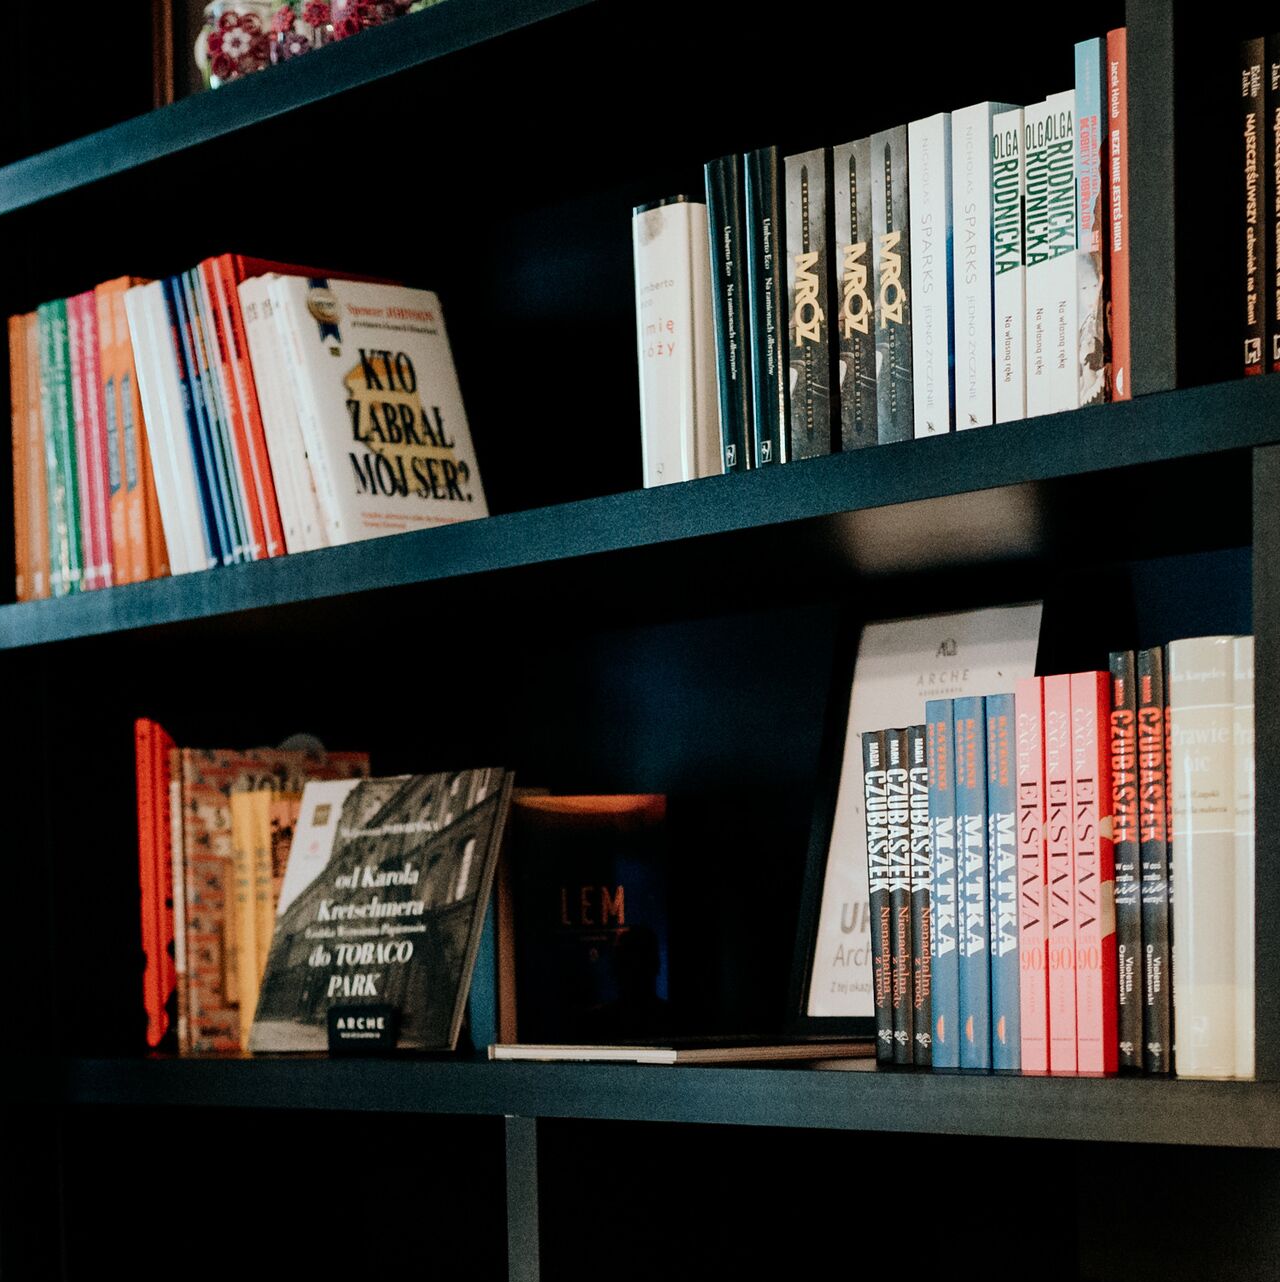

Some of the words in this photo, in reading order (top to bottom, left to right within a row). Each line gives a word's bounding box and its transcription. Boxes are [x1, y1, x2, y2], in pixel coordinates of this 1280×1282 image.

[1111, 61, 1119, 87] Jacek
[993, 128, 1018, 159] OLGA
[1025, 121, 1048, 151] OLGA
[1046, 111, 1073, 141] OLGA
[993, 158, 1020, 276] RUDNICKA
[1025, 149, 1048, 269] RUDNICKA
[1047, 140, 1075, 260] RUDNICKA
[880, 230, 906, 329] MRÓZ
[920, 214, 933, 295] SPARKS
[964, 203, 977, 285] SPARKS
[794, 250, 825, 348] MRÓZ
[844, 240, 873, 340] MRÓZ
[359, 348, 417, 394] KTO
[346, 399, 455, 449] ZABRAŁ
[349, 448, 410, 497] MÓJ
[411, 456, 473, 502] SER?
[917, 668, 970, 685] ARCHE
[869, 742, 879, 767] MARIA
[890, 739, 899, 765] MARIA
[914, 737, 923, 764] MARIA
[1138, 706, 1163, 844] CZUBASZEK
[864, 768, 890, 894] CZUBASZEK
[886, 767, 910, 894] CZUBASZEK
[909, 767, 930, 894] CZUBASZEK
[1021, 782, 1040, 930] EKSTAZA
[1049, 780, 1069, 930] EKSTAZA
[1077, 778, 1096, 929] EKSTAZA
[317, 896, 425, 922] Kretschmera
[335, 866, 357, 890] od
[361, 862, 420, 889] Karola
[559, 884, 626, 927] LEM
[935, 815, 956, 959] MATKA
[964, 813, 985, 958] MATKA
[997, 811, 1017, 958] MATKA
[308, 945, 332, 968] do
[334, 940, 413, 967] TOBACO
[327, 972, 382, 998] PARK
[336, 1016, 385, 1030] ARCHE
